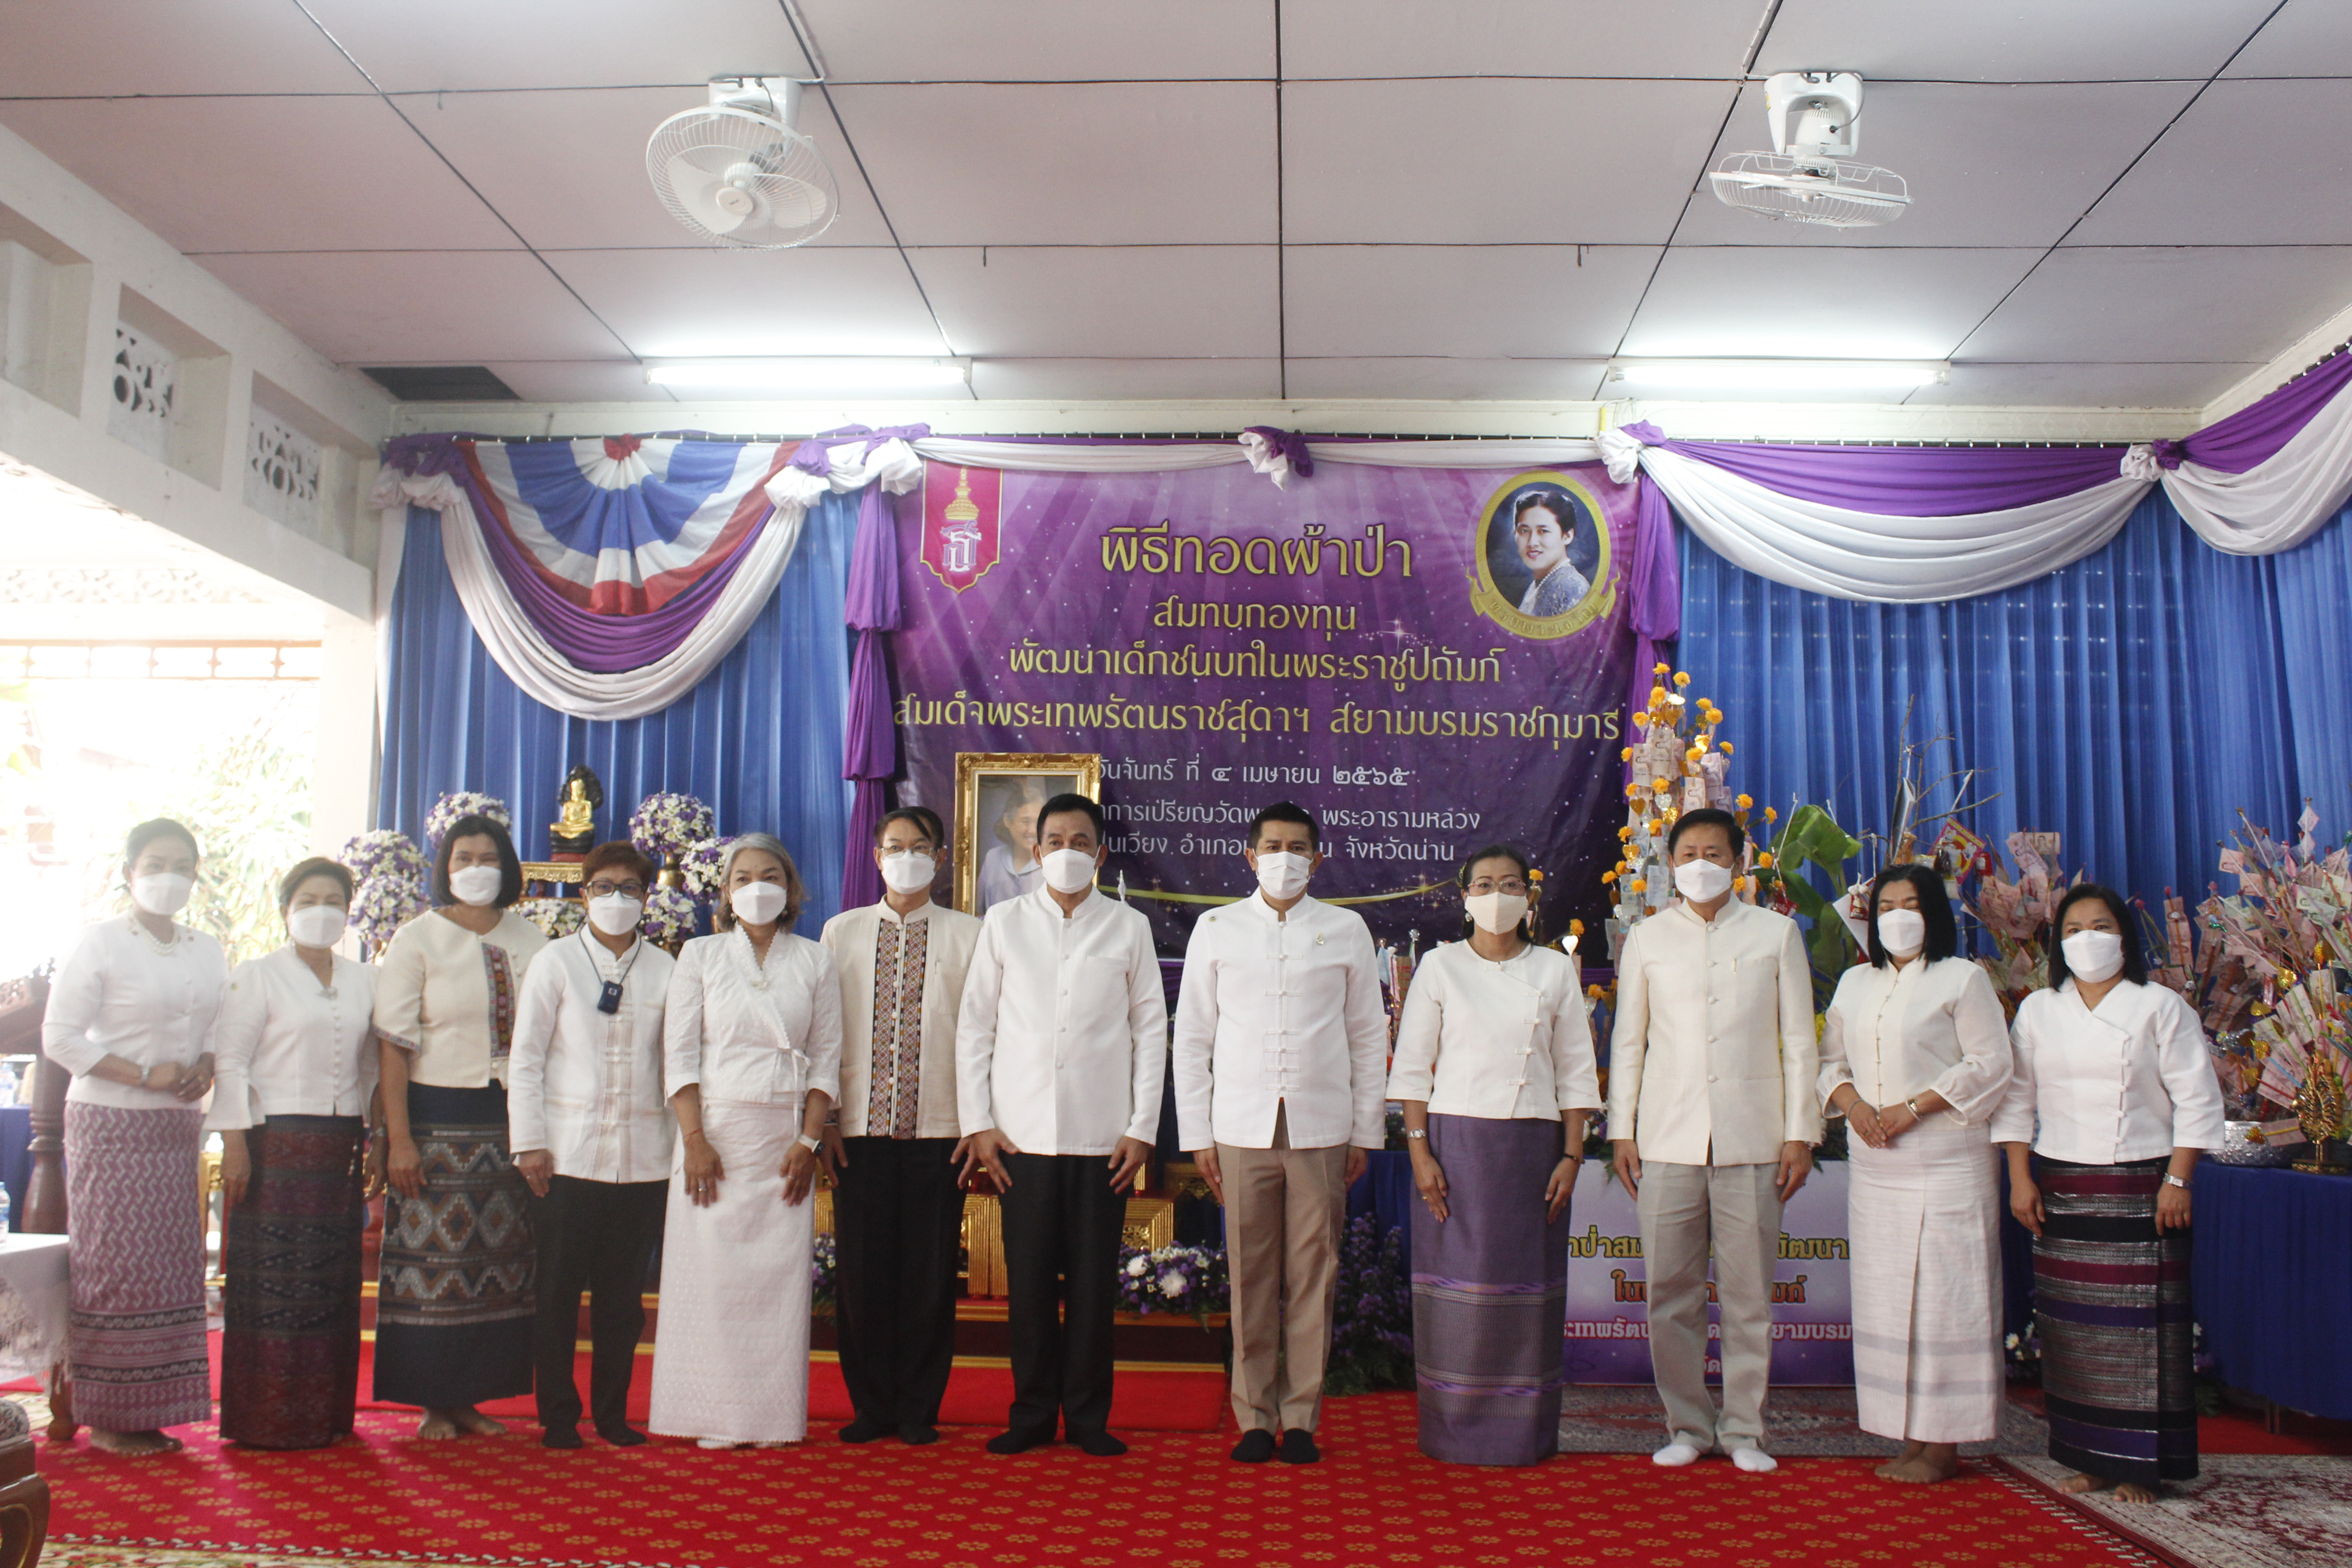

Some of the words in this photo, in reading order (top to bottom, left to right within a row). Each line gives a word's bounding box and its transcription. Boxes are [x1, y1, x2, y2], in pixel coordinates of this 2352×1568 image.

[1101, 519, 1412, 577] พิธีทอดผ้าป่า
[1153, 595, 1356, 641] สมทบกองทุน
[1009, 638, 1507, 692] พัฒนาเด็กชนบทในพระราชูปถัมภ์
[893, 690, 1310, 743] สมเด็จพระเทพรัตนราชสุดาฯ
[1329, 701, 1620, 750] สยามบรมราชกุมารี
[1186, 753, 1200, 781] ที่
[1211, 766, 1233, 782] ๔
[1243, 765, 1320, 784] เมษายน
[1333, 765, 1410, 786] ๒๕๖๕
[1323, 808, 1481, 829] พระอารามหลวง
[1344, 835, 1455, 861] จังหวัดน่าน
